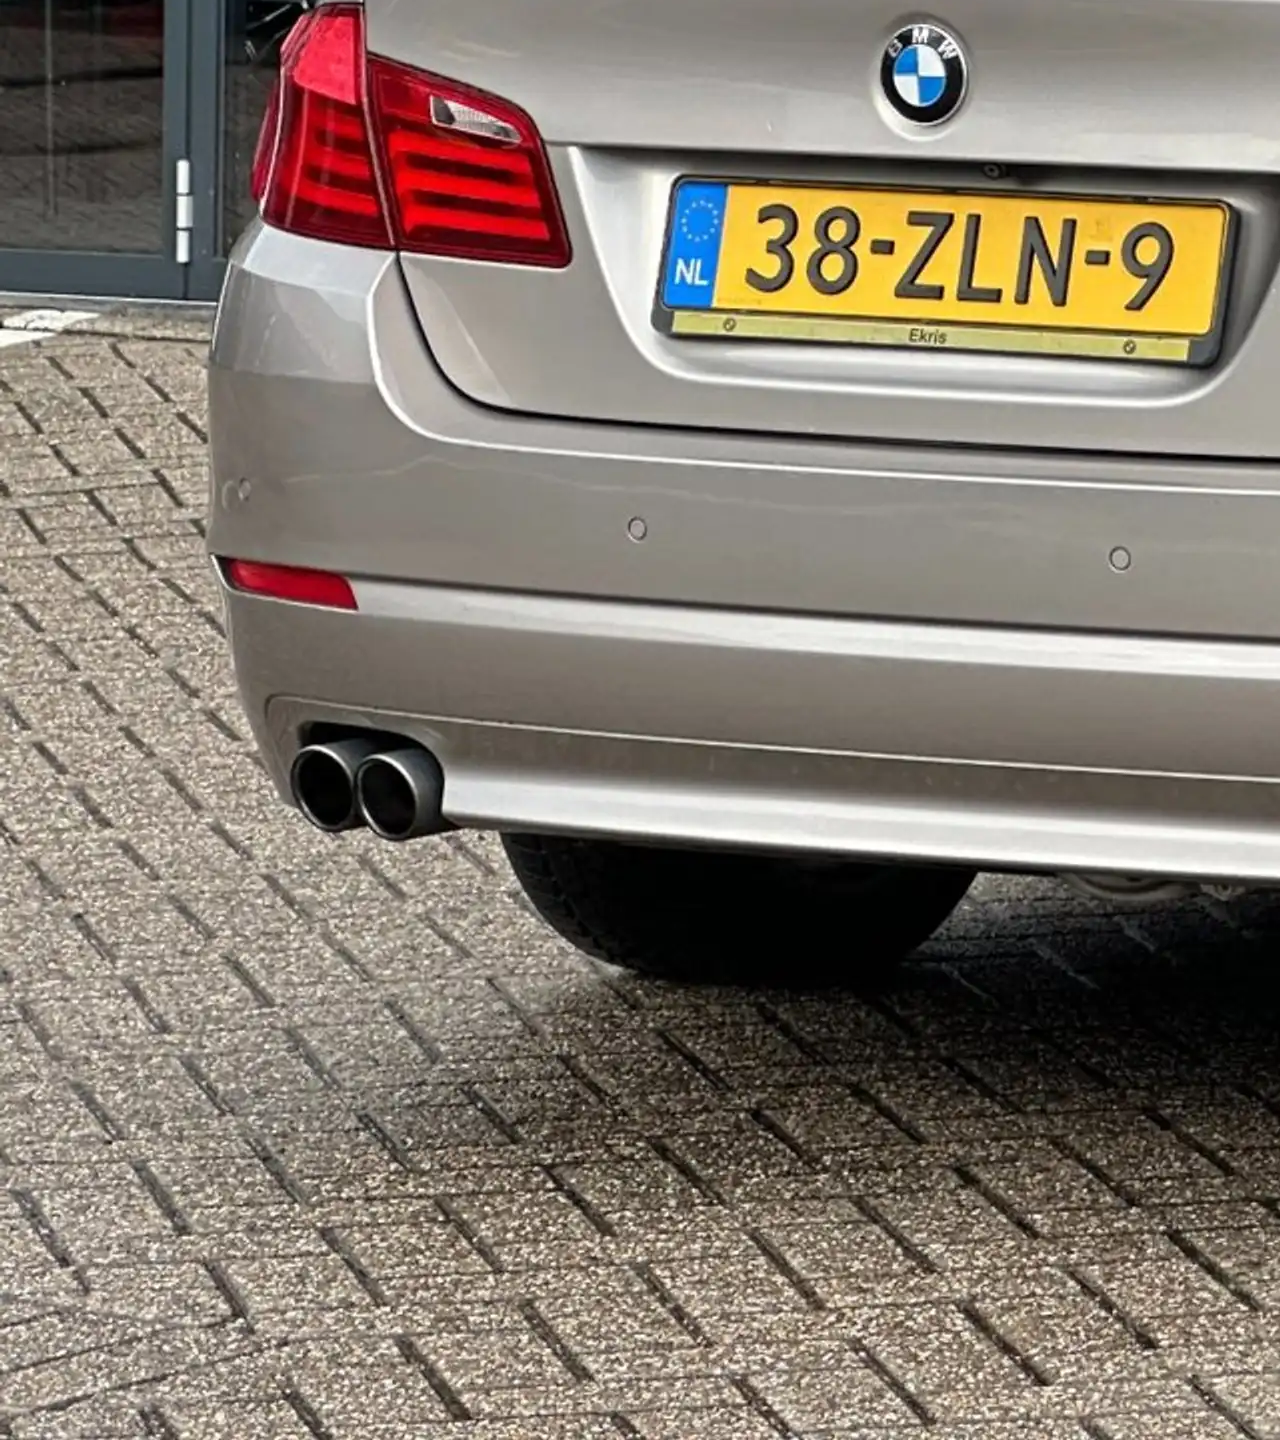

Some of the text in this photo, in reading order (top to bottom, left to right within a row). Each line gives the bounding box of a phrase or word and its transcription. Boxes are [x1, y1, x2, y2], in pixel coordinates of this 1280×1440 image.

[888, 26, 958, 60] BMW
[674, 257, 710, 288] NL
[744, 203, 1176, 312] 38-ZLN-9
[908, 327, 948, 346] Ekris
